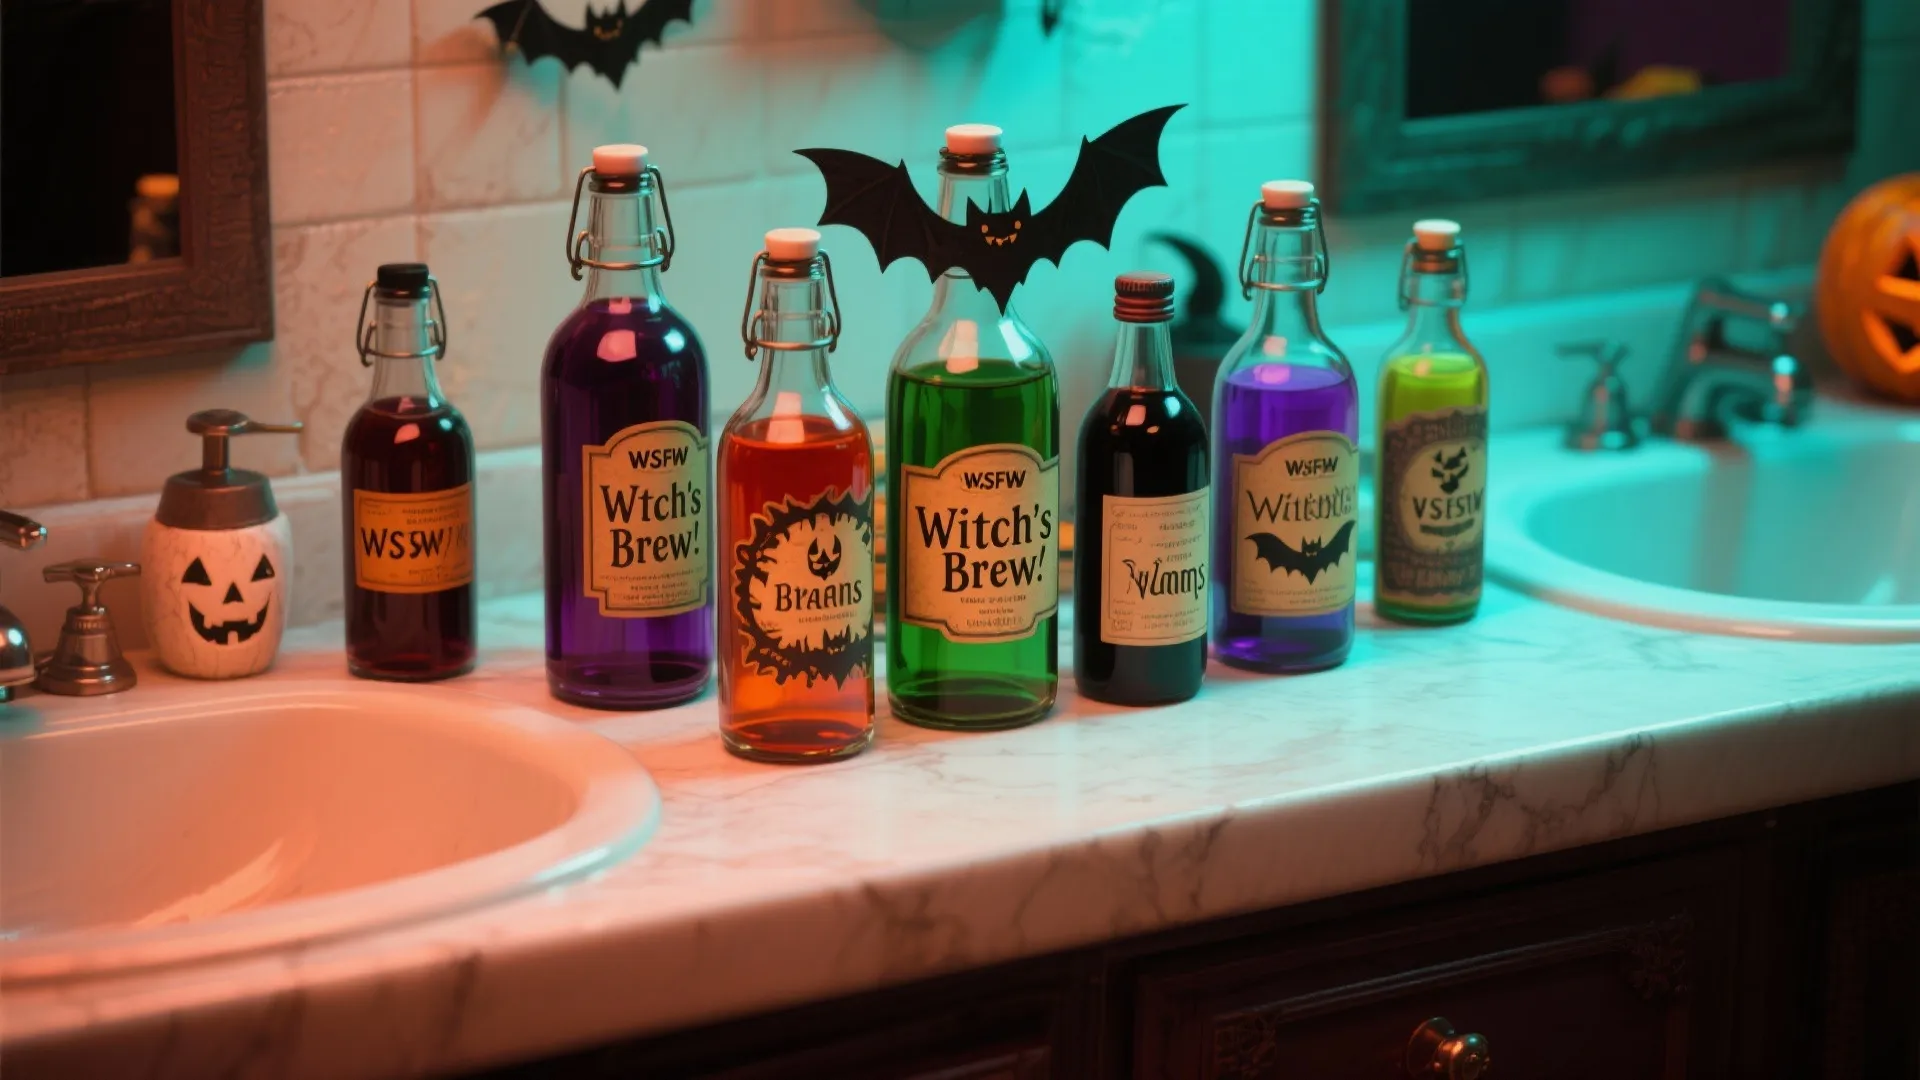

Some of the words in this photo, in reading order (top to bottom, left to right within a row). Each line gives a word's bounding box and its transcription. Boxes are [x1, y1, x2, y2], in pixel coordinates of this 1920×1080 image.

[628, 446, 689, 469] WSFW
[1285, 456, 1339, 477] WSFW
[600, 480, 701, 524] Wtch's
[610, 521, 699, 568] Brew!
[915, 503, 1052, 550] Witch's
[942, 545, 1046, 592] Brew!
